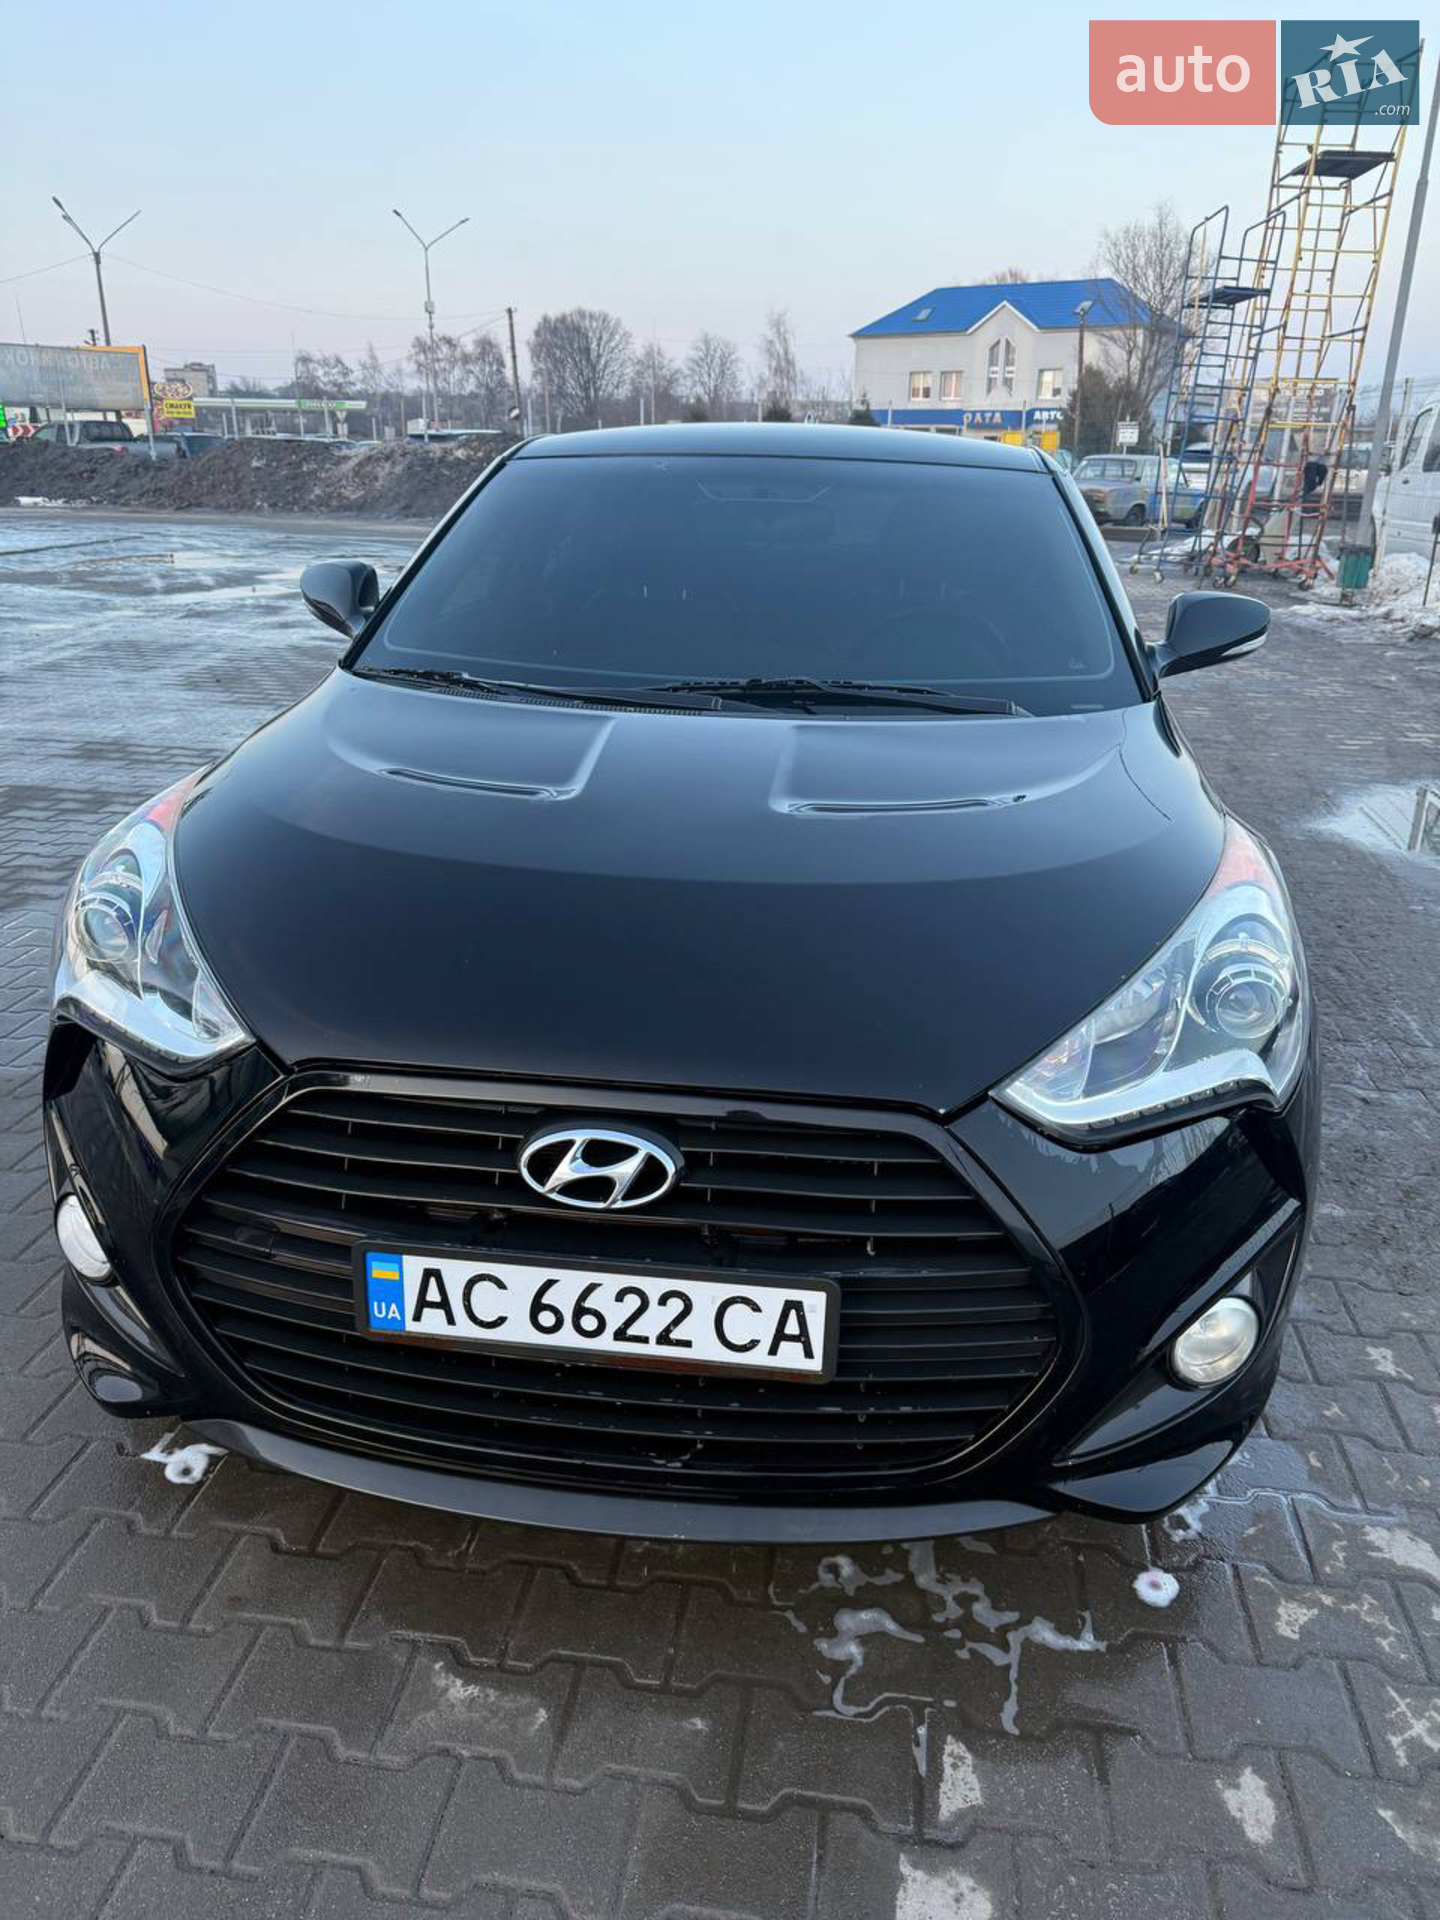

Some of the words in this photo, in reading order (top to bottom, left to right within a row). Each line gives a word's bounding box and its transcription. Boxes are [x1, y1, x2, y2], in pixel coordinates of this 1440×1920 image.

[373, 1301, 402, 1321] UA
[412, 1267, 509, 1330] AC
[529, 1278, 694, 1349] 6622
[714, 1295, 816, 1360] CA
